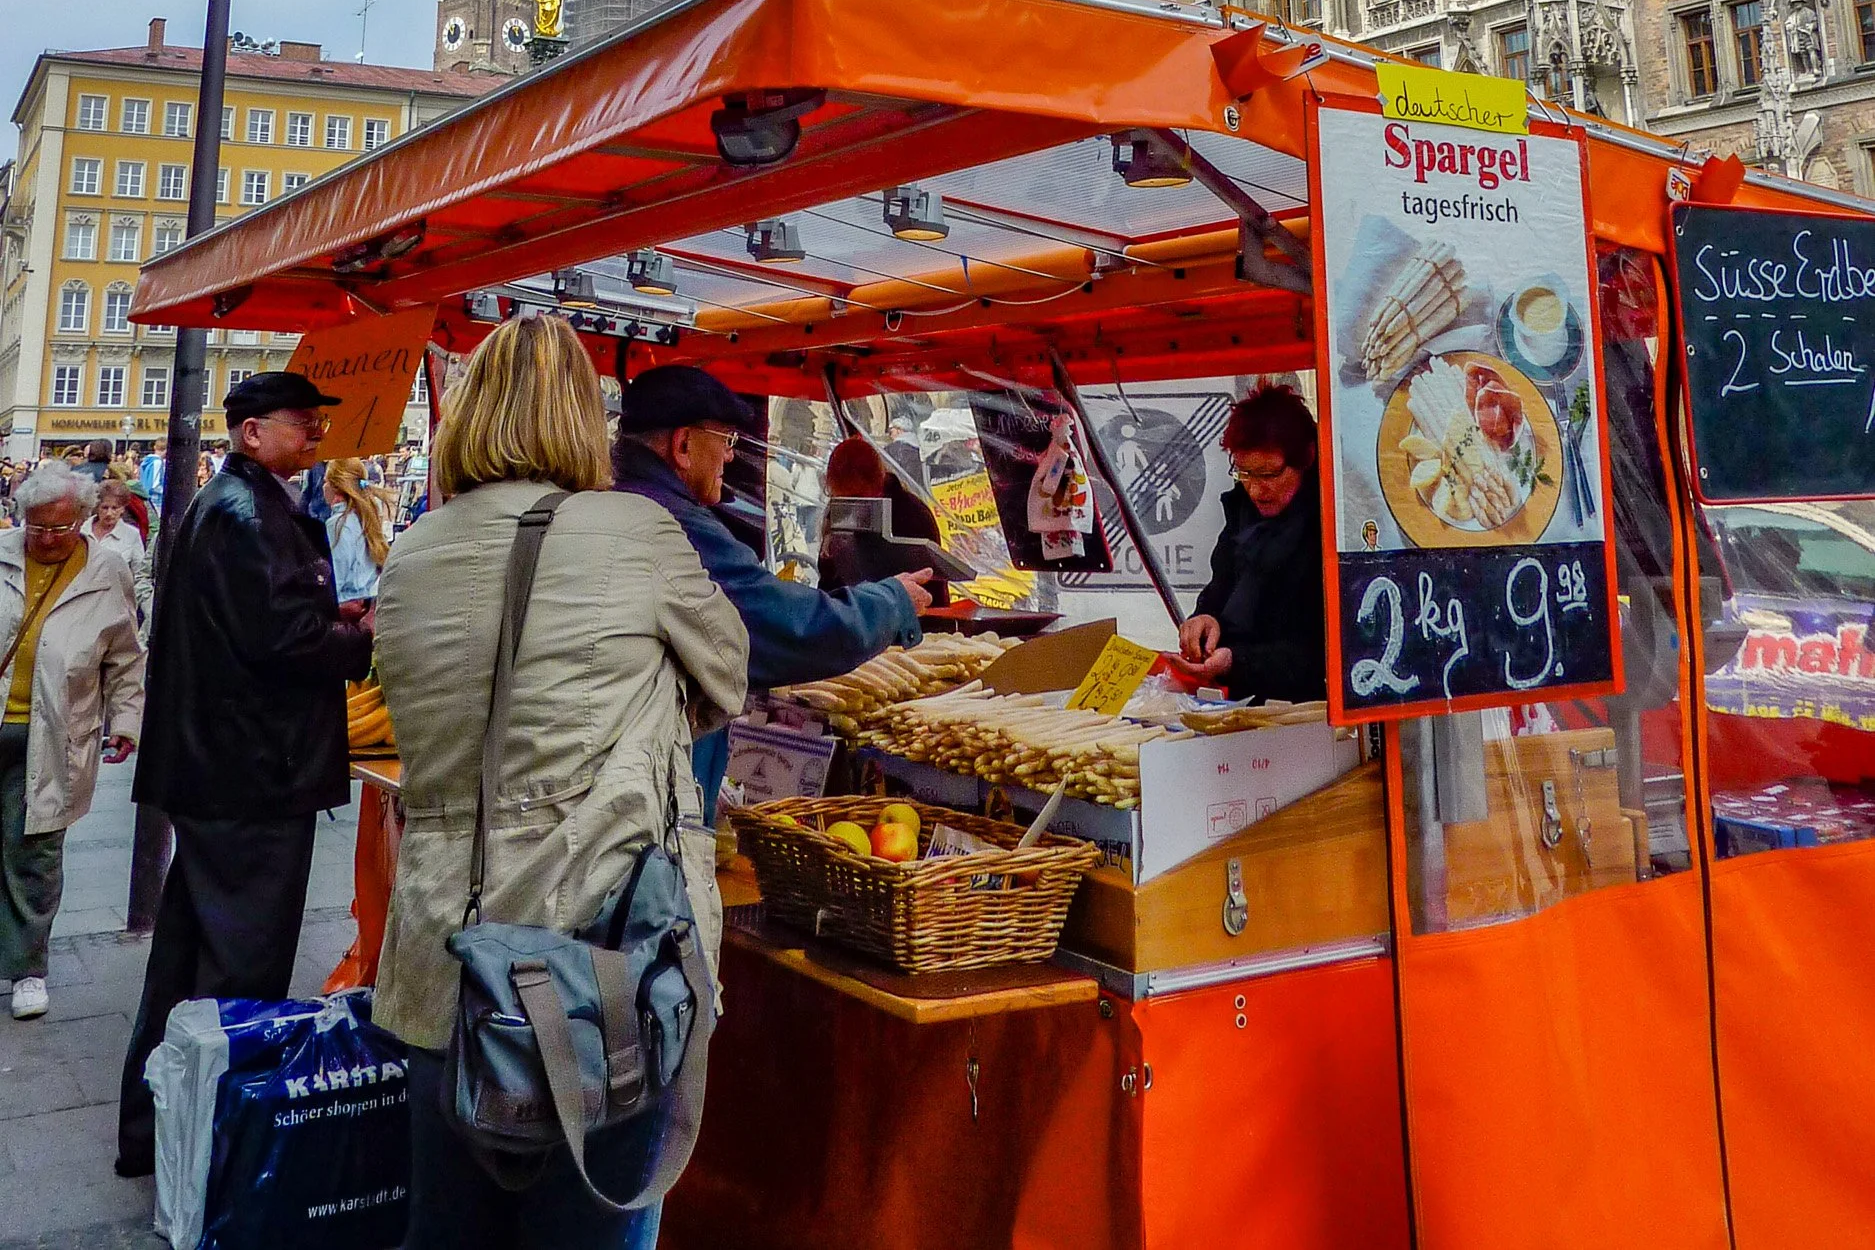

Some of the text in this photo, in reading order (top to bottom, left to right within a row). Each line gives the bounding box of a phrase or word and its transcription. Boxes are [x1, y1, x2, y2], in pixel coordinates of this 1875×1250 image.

[1396, 81, 1513, 127] deutscher
[1384, 123, 1531, 190] Spargel
[1401, 191, 1519, 224] tagesfrisch
[1695, 244, 1795, 301] Süsse
[1721, 330, 1866, 398] 2 Schalen
[1351, 577, 1420, 697] 2
[1415, 571, 1469, 700] kg
[382, 1093, 395, 1107] in
